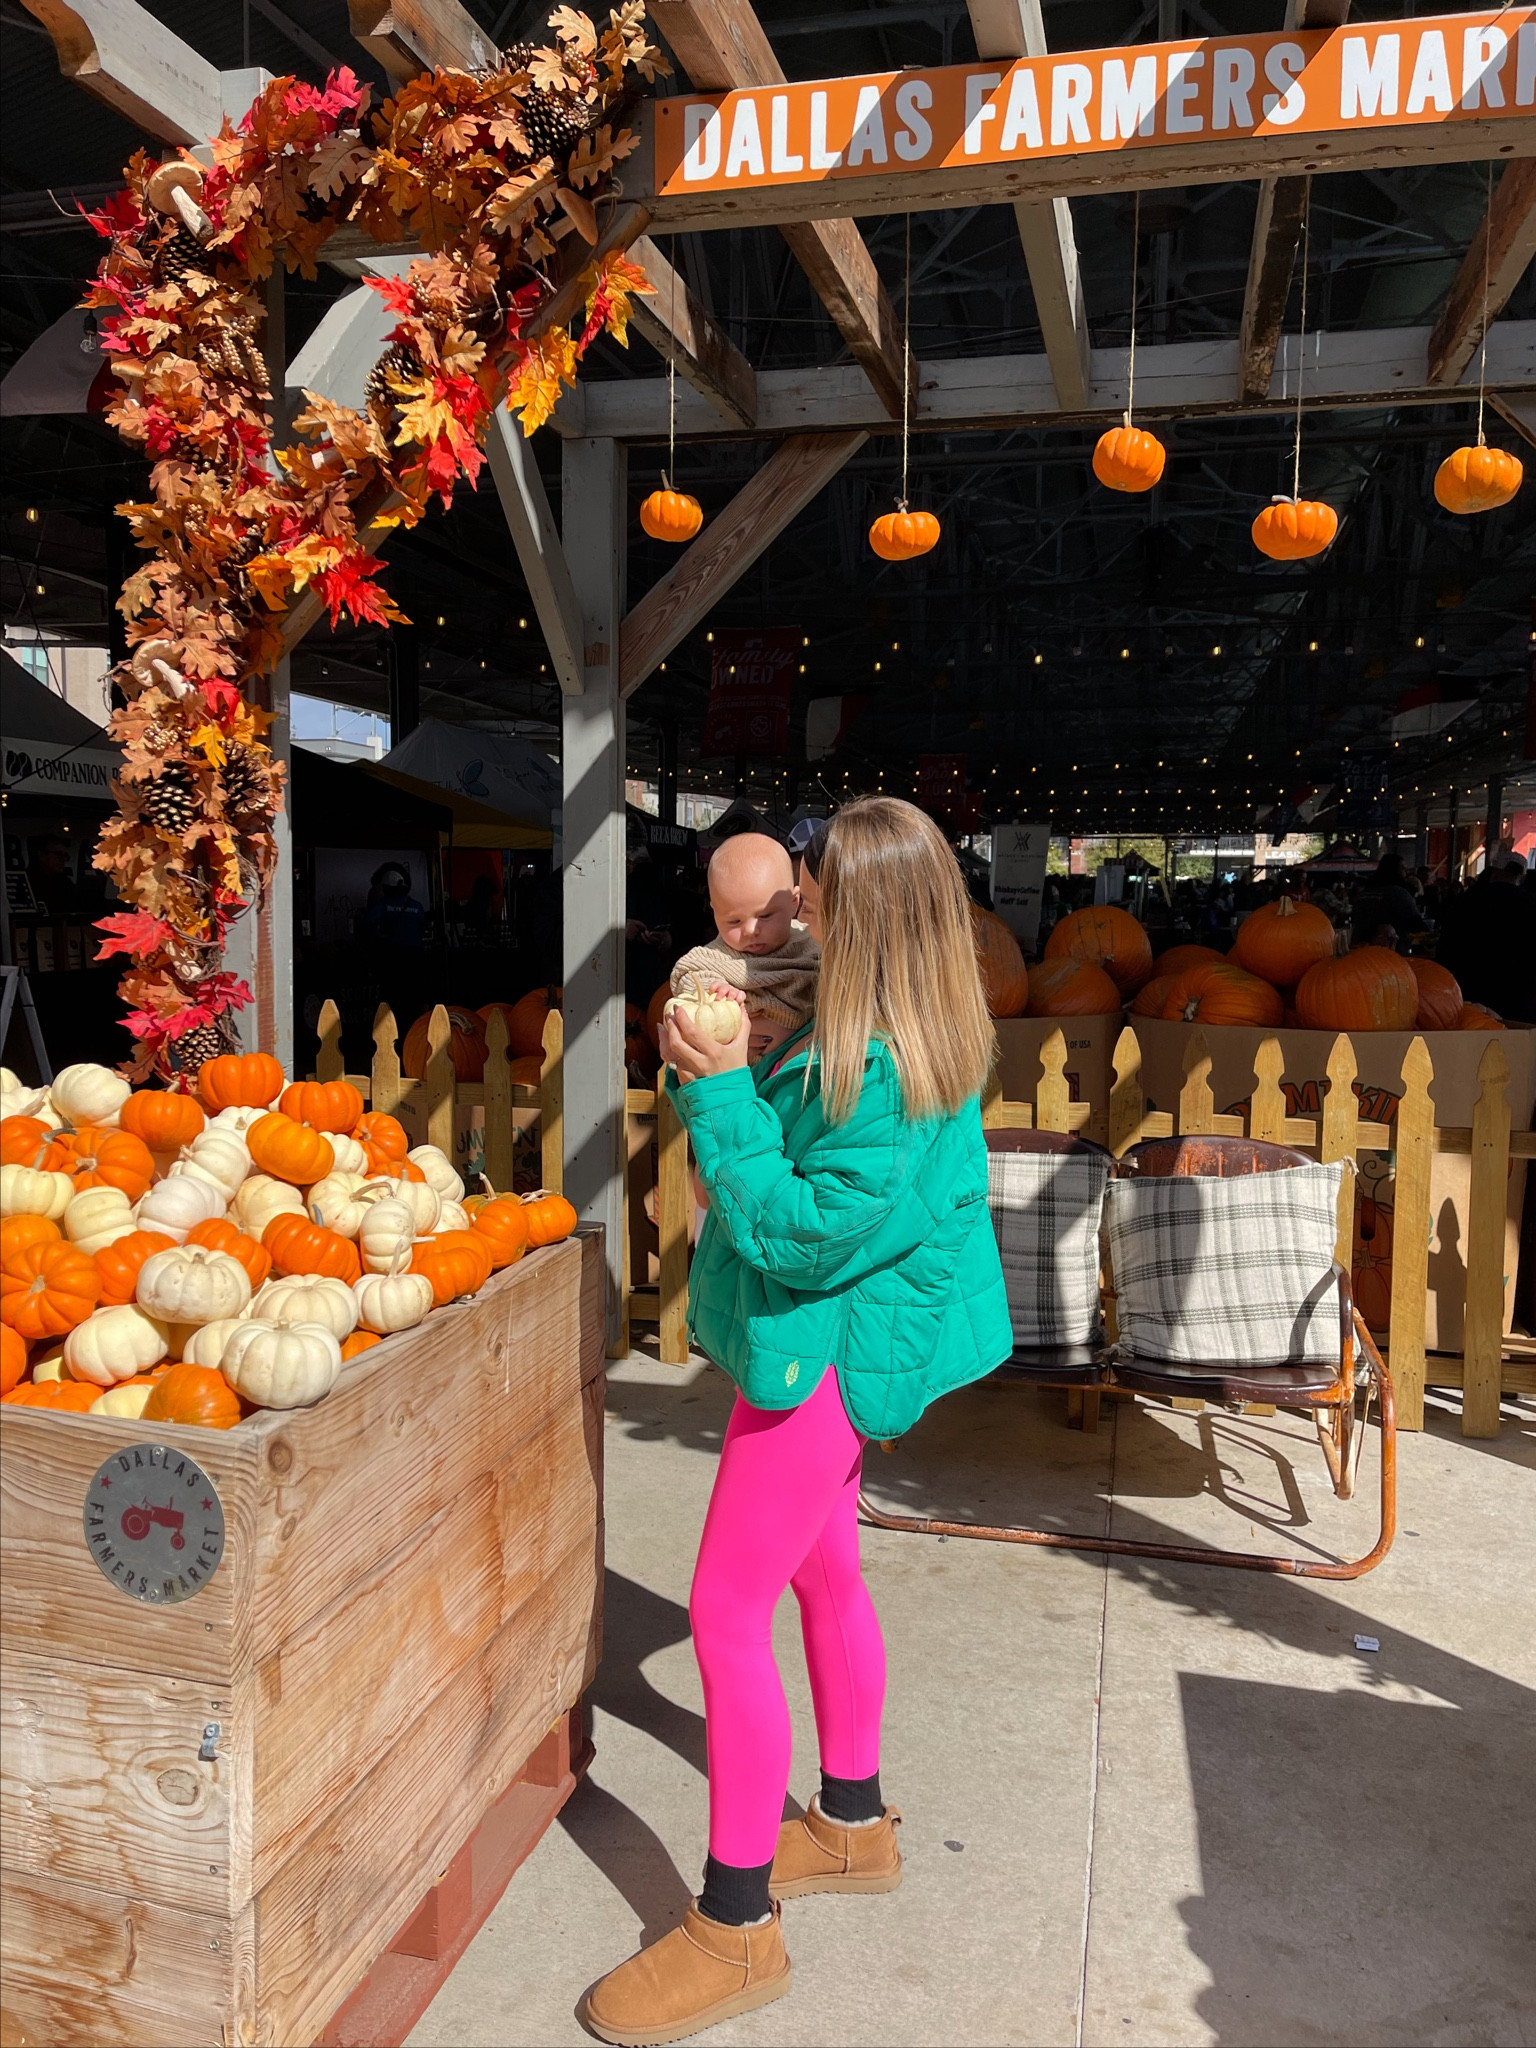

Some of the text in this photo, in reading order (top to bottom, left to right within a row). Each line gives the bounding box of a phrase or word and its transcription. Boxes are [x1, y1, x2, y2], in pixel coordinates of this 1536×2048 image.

[682, 79, 933, 181] DALLAS
[964, 41, 1306, 155] FARMERS
[35, 757, 108, 786] COMPANION
[118, 1450, 200, 1488] DALLAS
[88, 1501, 149, 1594] FARMERS
[162, 1527, 220, 1597] MARKET
